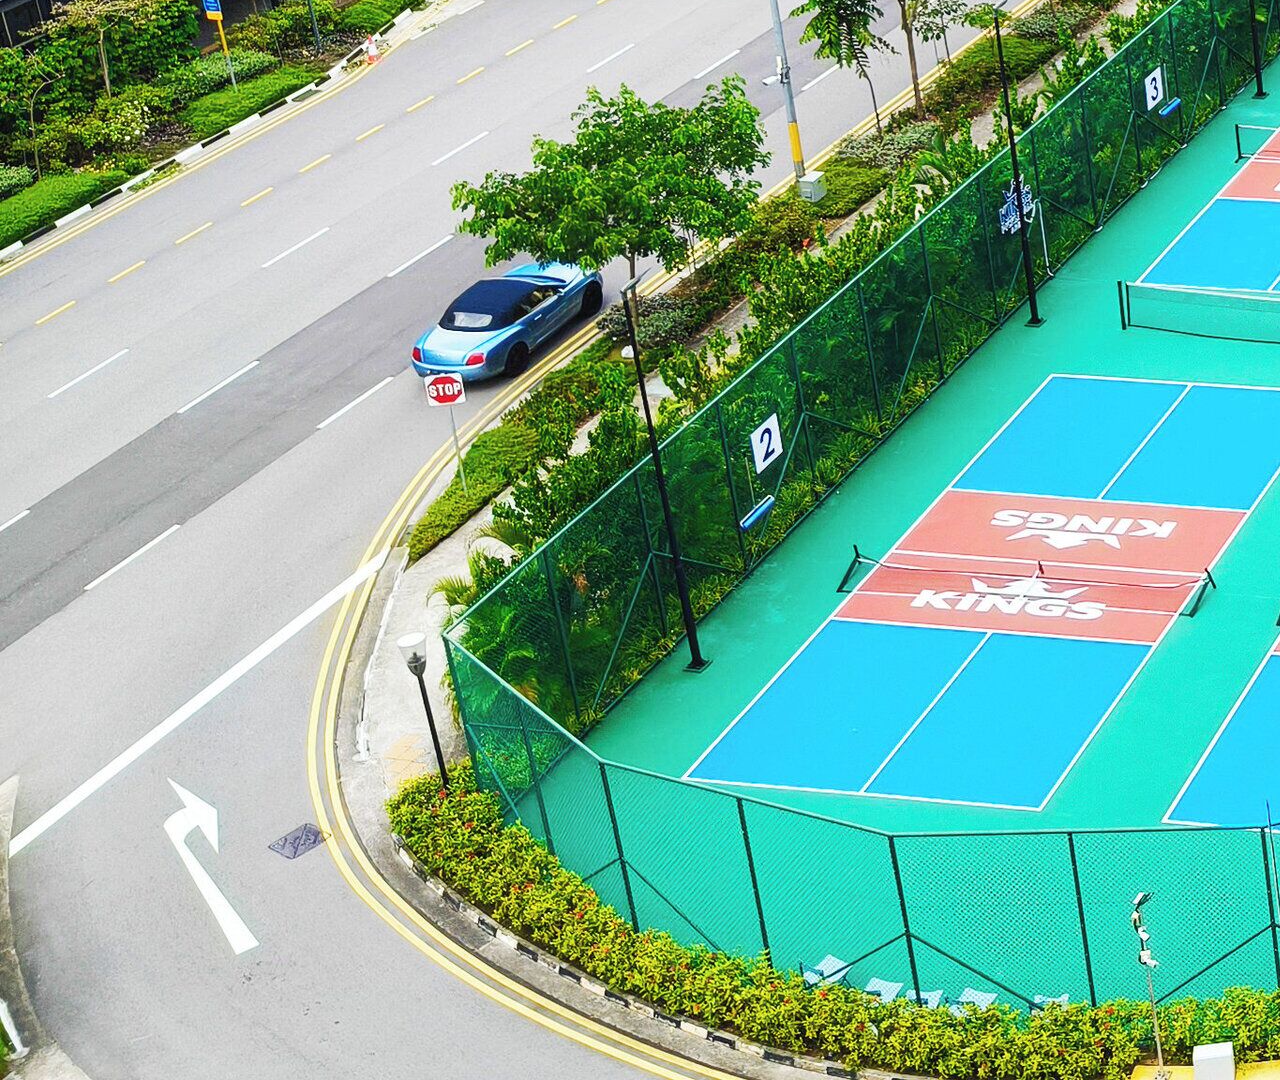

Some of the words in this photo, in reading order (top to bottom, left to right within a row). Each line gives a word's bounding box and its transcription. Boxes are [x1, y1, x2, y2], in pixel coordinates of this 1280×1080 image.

[1149, 76, 1160, 102] 3
[428, 382, 461, 398] STOP
[760, 427, 776, 463] 2
[990, 509, 1178, 539] KINGS
[909, 589, 1107, 621] KINGS
